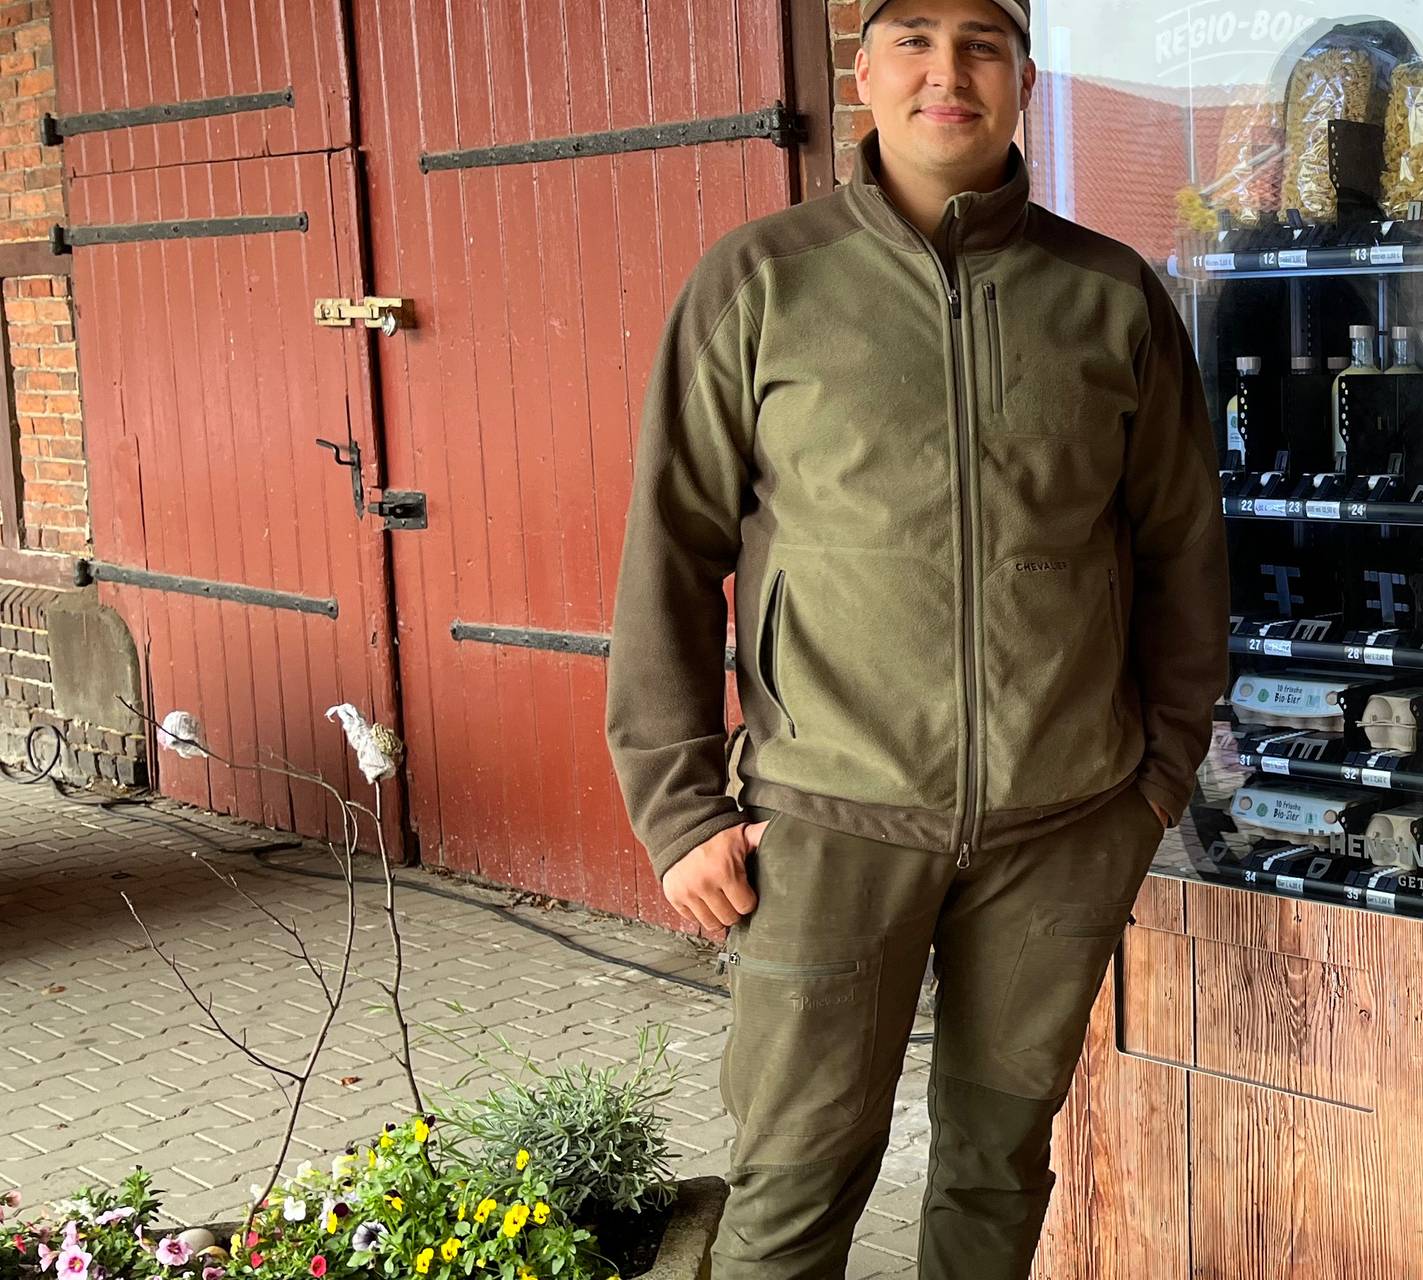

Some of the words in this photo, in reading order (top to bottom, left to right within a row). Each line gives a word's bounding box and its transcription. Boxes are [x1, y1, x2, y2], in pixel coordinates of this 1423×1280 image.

[1192, 255, 1203, 267] 11
[1263, 253, 1275, 264] 12
[1355, 249, 1367, 261] 13
[1241, 499, 1253, 511] 22
[1288, 501, 1300, 513] 23
[1351, 504, 1364, 516] 24
[1249, 639, 1261, 650] 27
[1347, 648, 1360, 660] 28
[1240, 754, 1250, 766] 31
[1344, 769, 1356, 780] 32
[1244, 871, 1257, 883] 34
[1346, 889, 1359, 900] 35
